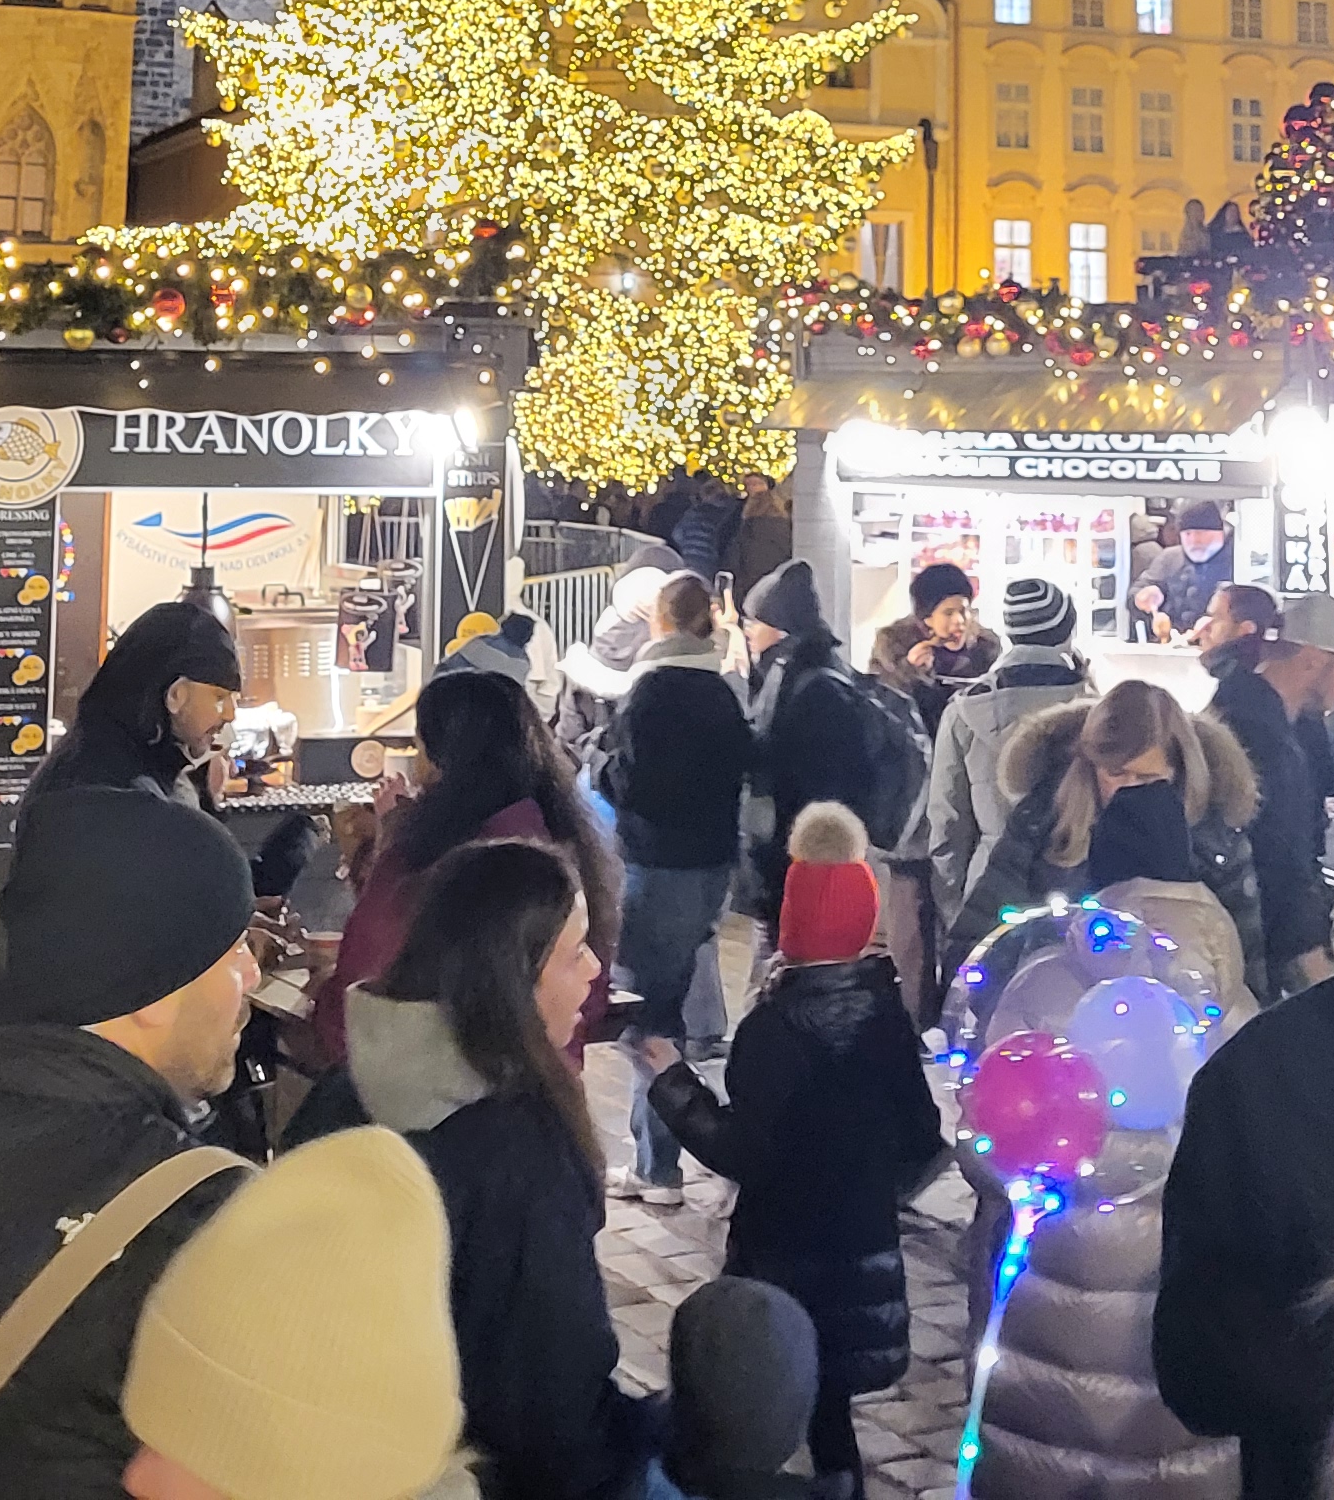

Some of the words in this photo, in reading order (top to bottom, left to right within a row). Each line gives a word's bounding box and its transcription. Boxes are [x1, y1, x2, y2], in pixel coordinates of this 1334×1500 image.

[110, 410, 427, 456] HRANOLKY
[447, 469, 501, 487] STRIPS
[1015, 457, 1222, 482] CHOCOLATE
